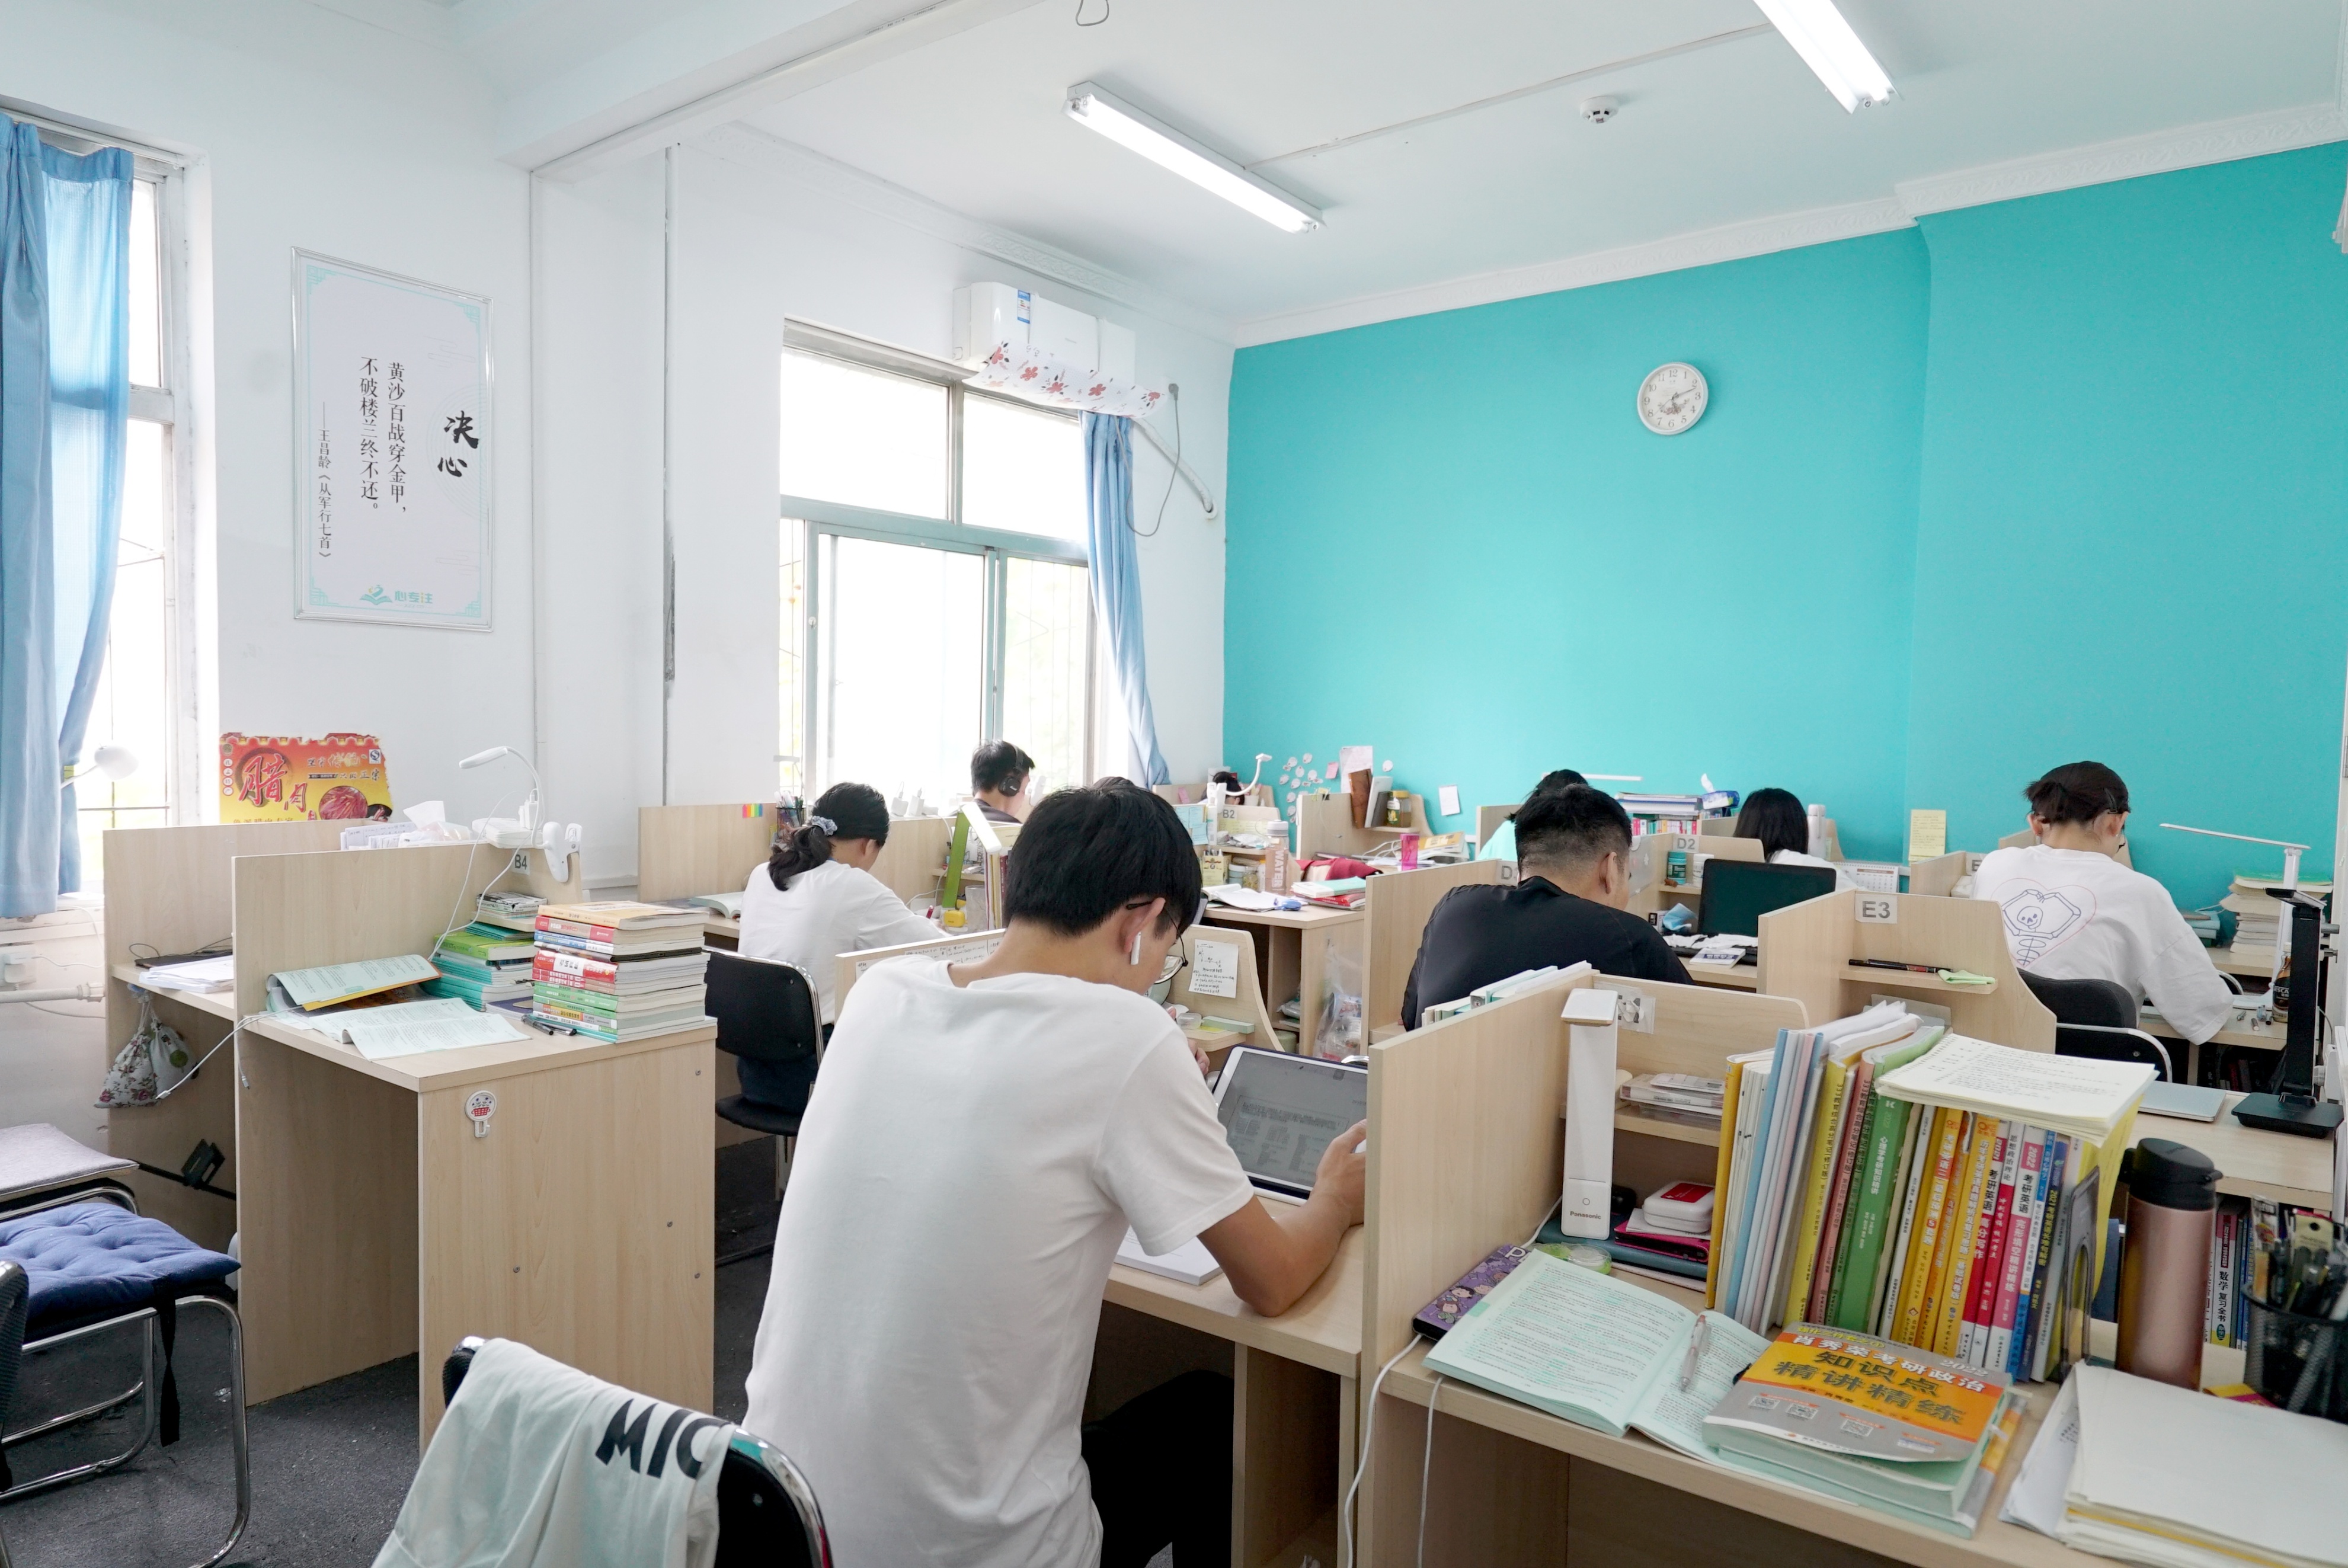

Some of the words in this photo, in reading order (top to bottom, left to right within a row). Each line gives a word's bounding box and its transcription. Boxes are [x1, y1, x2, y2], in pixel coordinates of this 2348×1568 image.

[1658, 373, 1665, 382] 11
[1669, 369, 1678, 378] 12
[1684, 371, 1687, 379] 1
[1648, 383, 1657, 392] 10
[1691, 379, 1698, 388] 2
[1644, 396, 1650, 405] 9
[1695, 392, 1701, 401] 3
[1690, 405, 1696, 414] 4
[1657, 417, 1663, 425] 7
[1668, 420, 1675, 428] 6
[359, 357, 379, 509] 不破楼兰终不还。
[387, 361, 407, 513] 黄沙百战穿金甲，
[437, 410, 479, 478] 决心
[1223, 809, 1234, 819] B2
[1677, 838, 1696, 849] D2
[514, 854, 527, 870] B4
[1271, 849, 1284, 888] WATER
[1862, 901, 1890, 919] E3
[2003, 1135, 2018, 1182] 思想政治理论
[2026, 1146, 2038, 1169] 2022
[1983, 1169, 1998, 1211] 考研英语
[2019, 1174, 2033, 1214] 考研英语
[1570, 1211, 1602, 1220] Panasonic
[1974, 1218, 1991, 1259] 高分写作
[2218, 1271, 2229, 1291] 数学
[2218, 1292, 2227, 1323] 复习全书
[1793, 1335, 1986, 1393] 肖秀荣考研政治
[1939, 1359, 1989, 1378] 2022
[1814, 1351, 1943, 1397] 知识点
[1774, 1361, 1966, 1425] 精讲精练
